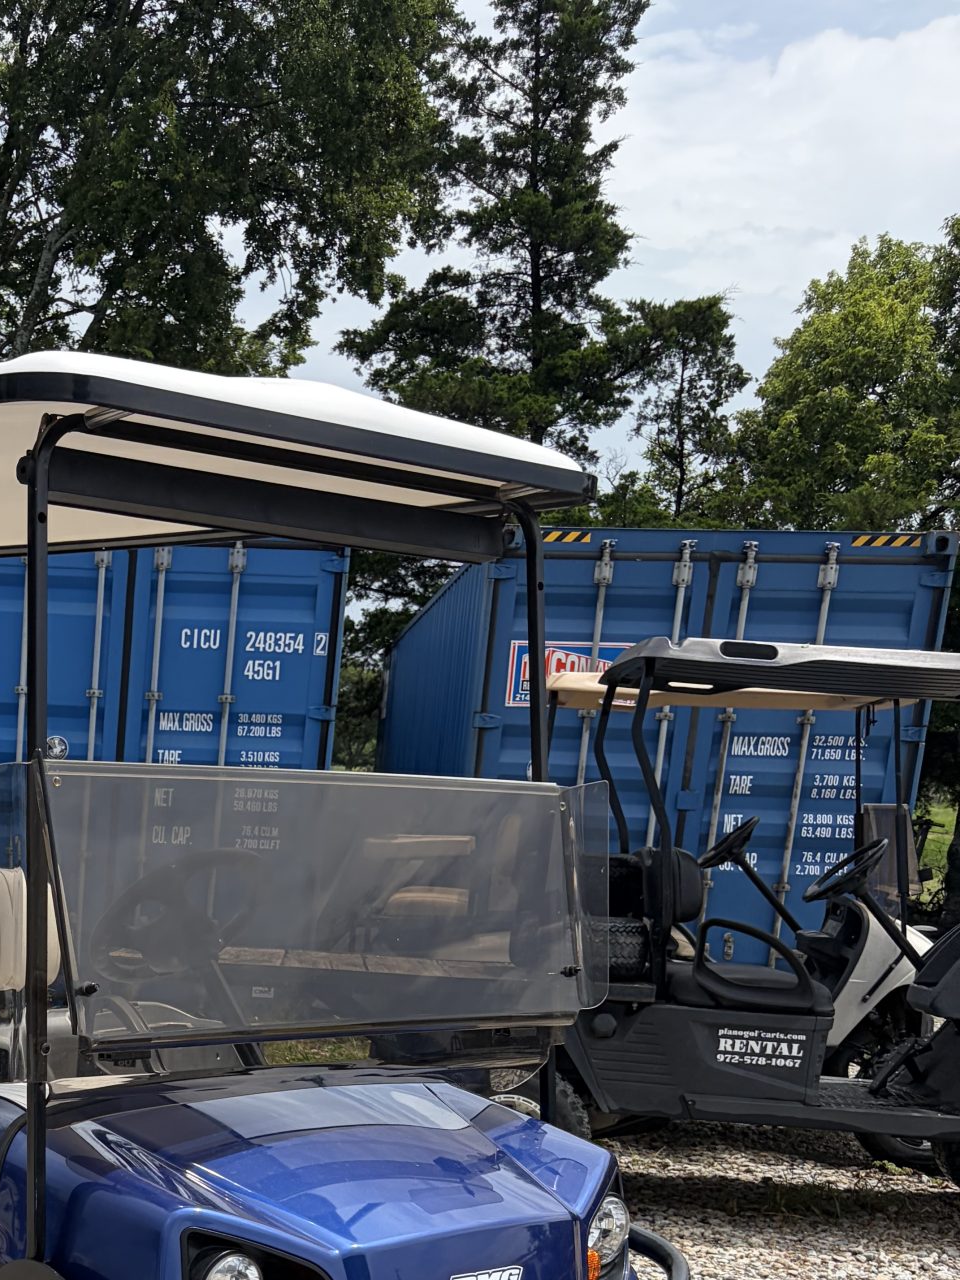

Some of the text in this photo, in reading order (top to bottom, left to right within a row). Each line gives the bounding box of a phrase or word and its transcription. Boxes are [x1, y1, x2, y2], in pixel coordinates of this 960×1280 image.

[181, 628, 328, 655] CICU 248354 2
[244, 660, 281, 681] 45G1
[159, 712, 214, 732] MAX.GROSS
[238, 713, 283, 724] 30.480 KGS
[237, 726, 282, 737] 67.200 LBS
[731, 736, 791, 757] MAX.GROSS
[240, 751, 280, 762] 3.510 KGS
[729, 775, 753, 795] TARE
[813, 774, 839, 786] 3.700
[154, 788, 174, 807] NET
[263, 789, 279, 800] KGS
[262, 801, 279, 812] LBS
[802, 813, 833, 825] 28.800
[152, 826, 192, 845] CU. CAP.
[801, 826, 832, 838] 63.490
[802, 851, 821, 863] 76.4
[795, 864, 820, 875] 2.700
[718, 1037, 804, 1057] RENTAL
[716, 1053, 802, 1068] 972-578-1067
